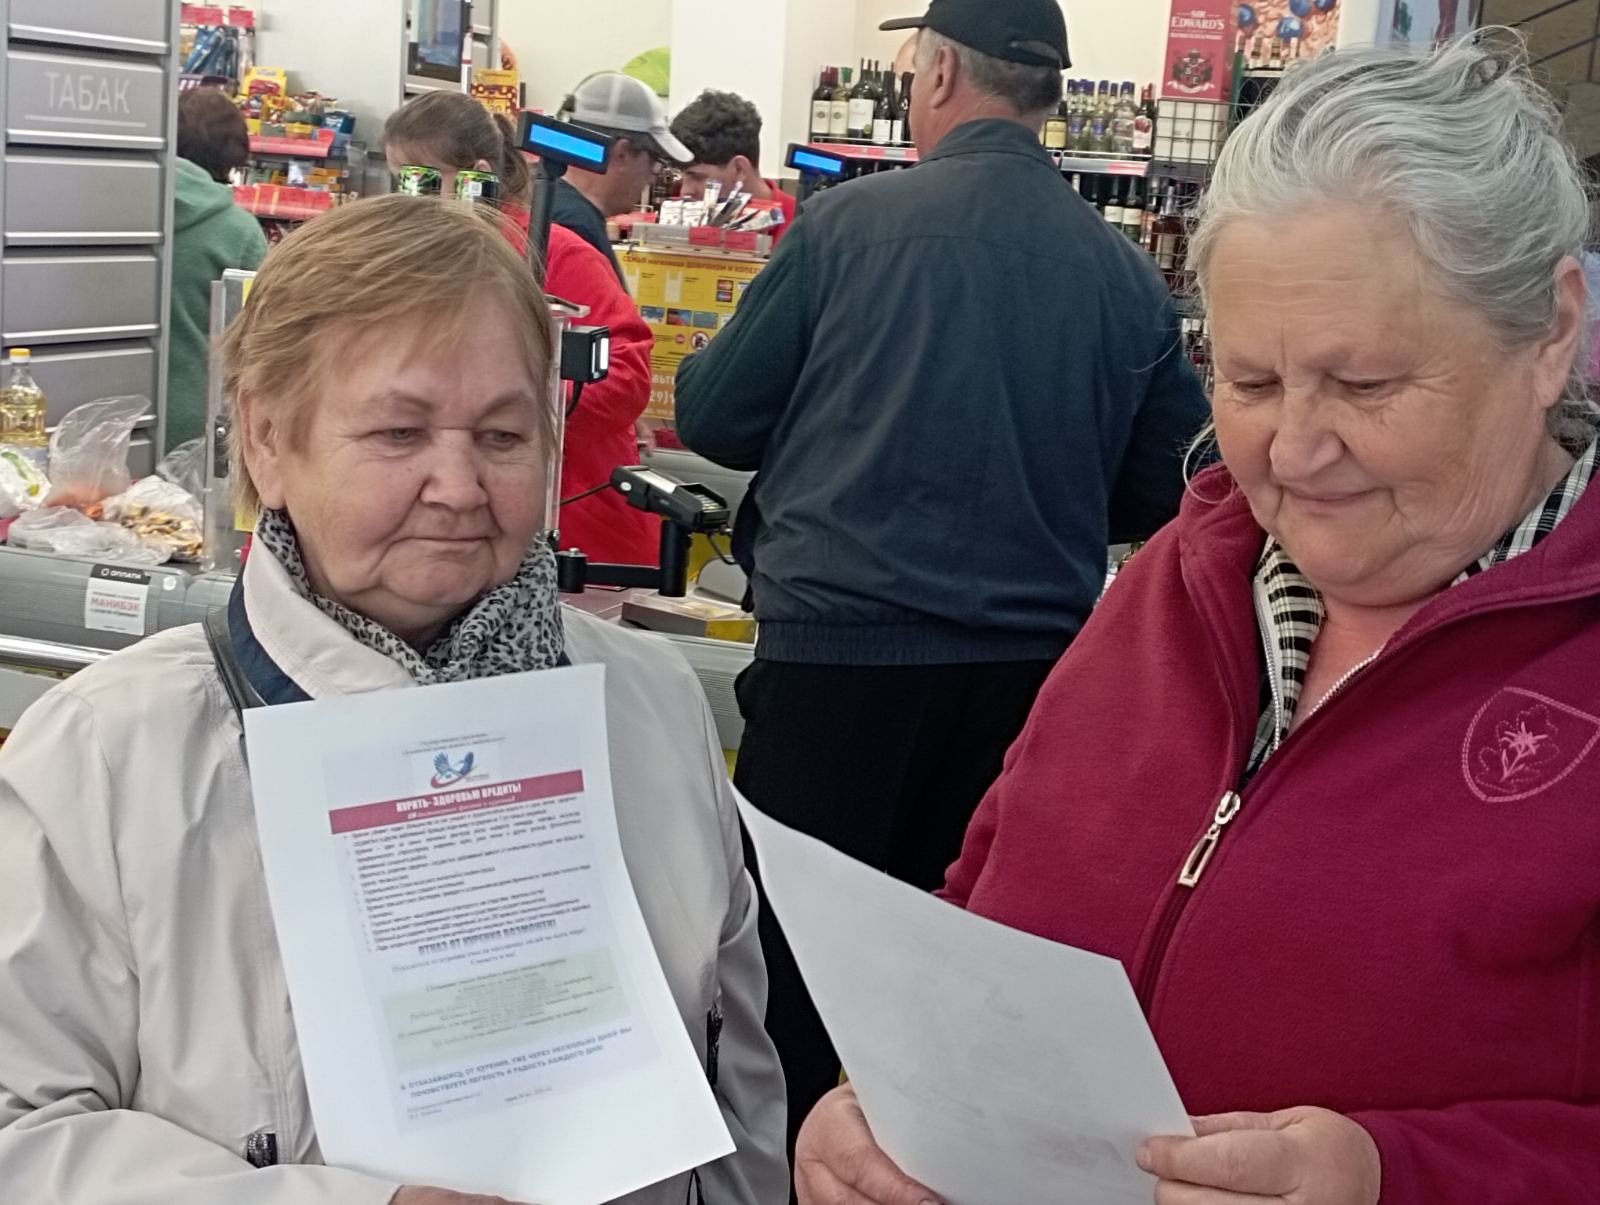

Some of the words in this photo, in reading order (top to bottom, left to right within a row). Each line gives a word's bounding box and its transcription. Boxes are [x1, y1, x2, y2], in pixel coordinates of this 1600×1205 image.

[44, 71, 131, 114] ТАБАК
[91, 597, 141, 612] МАНИБЭК
[433, 789, 481, 807] ЗДОРОВЬЮ
[481, 782, 522, 800] ВРЕДИТЬ!
